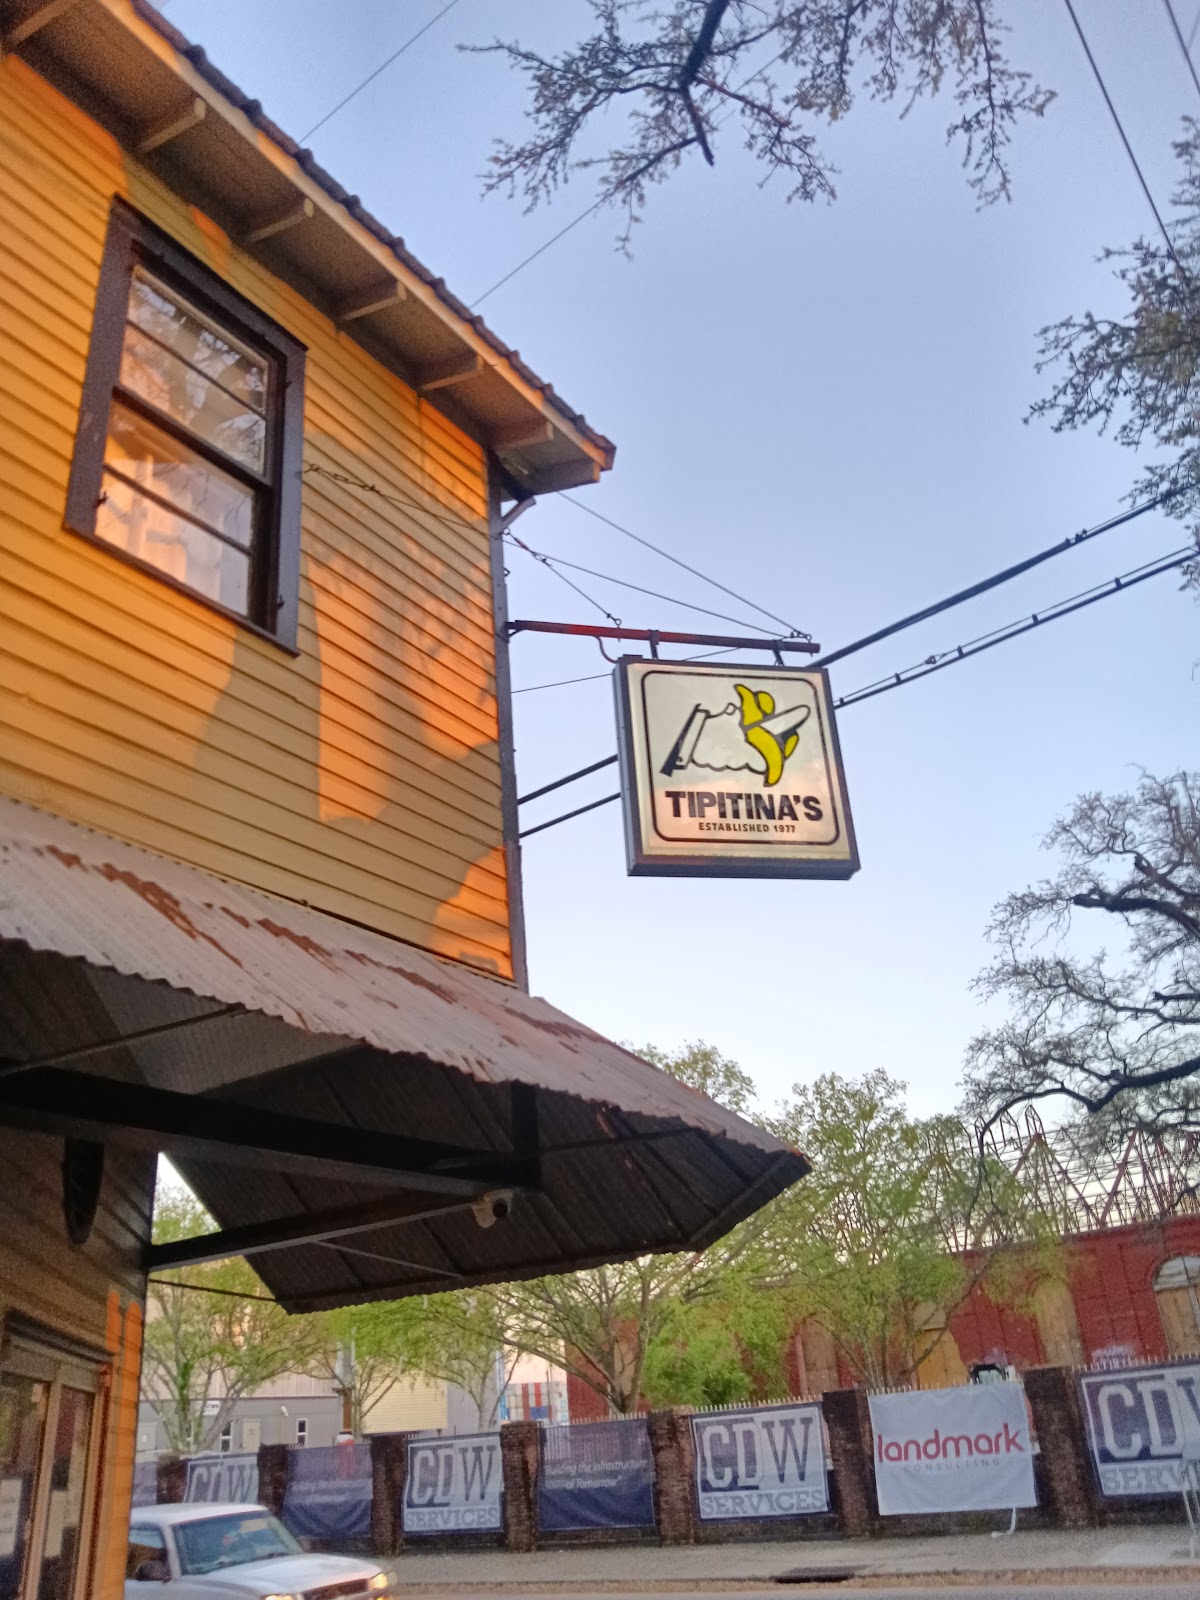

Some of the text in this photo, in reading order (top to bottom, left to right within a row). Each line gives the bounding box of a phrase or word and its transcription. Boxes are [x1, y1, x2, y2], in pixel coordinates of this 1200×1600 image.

[665, 791, 823, 821] TIPITINA'S
[699, 822, 795, 833] ESTABLISHED 1977
[702, 1417, 813, 1488] CDW
[877, 1423, 1025, 1463] landmark
[411, 1444, 496, 1505] CDW
[544, 1463, 577, 1476] Building
[578, 1461, 592, 1473] the
[903, 1457, 1000, 1473] CONSULTING
[566, 1478, 618, 1490] of Tomorrow
[701, 1489, 826, 1516] SERVICES
[404, 1507, 499, 1529] SERVICES
